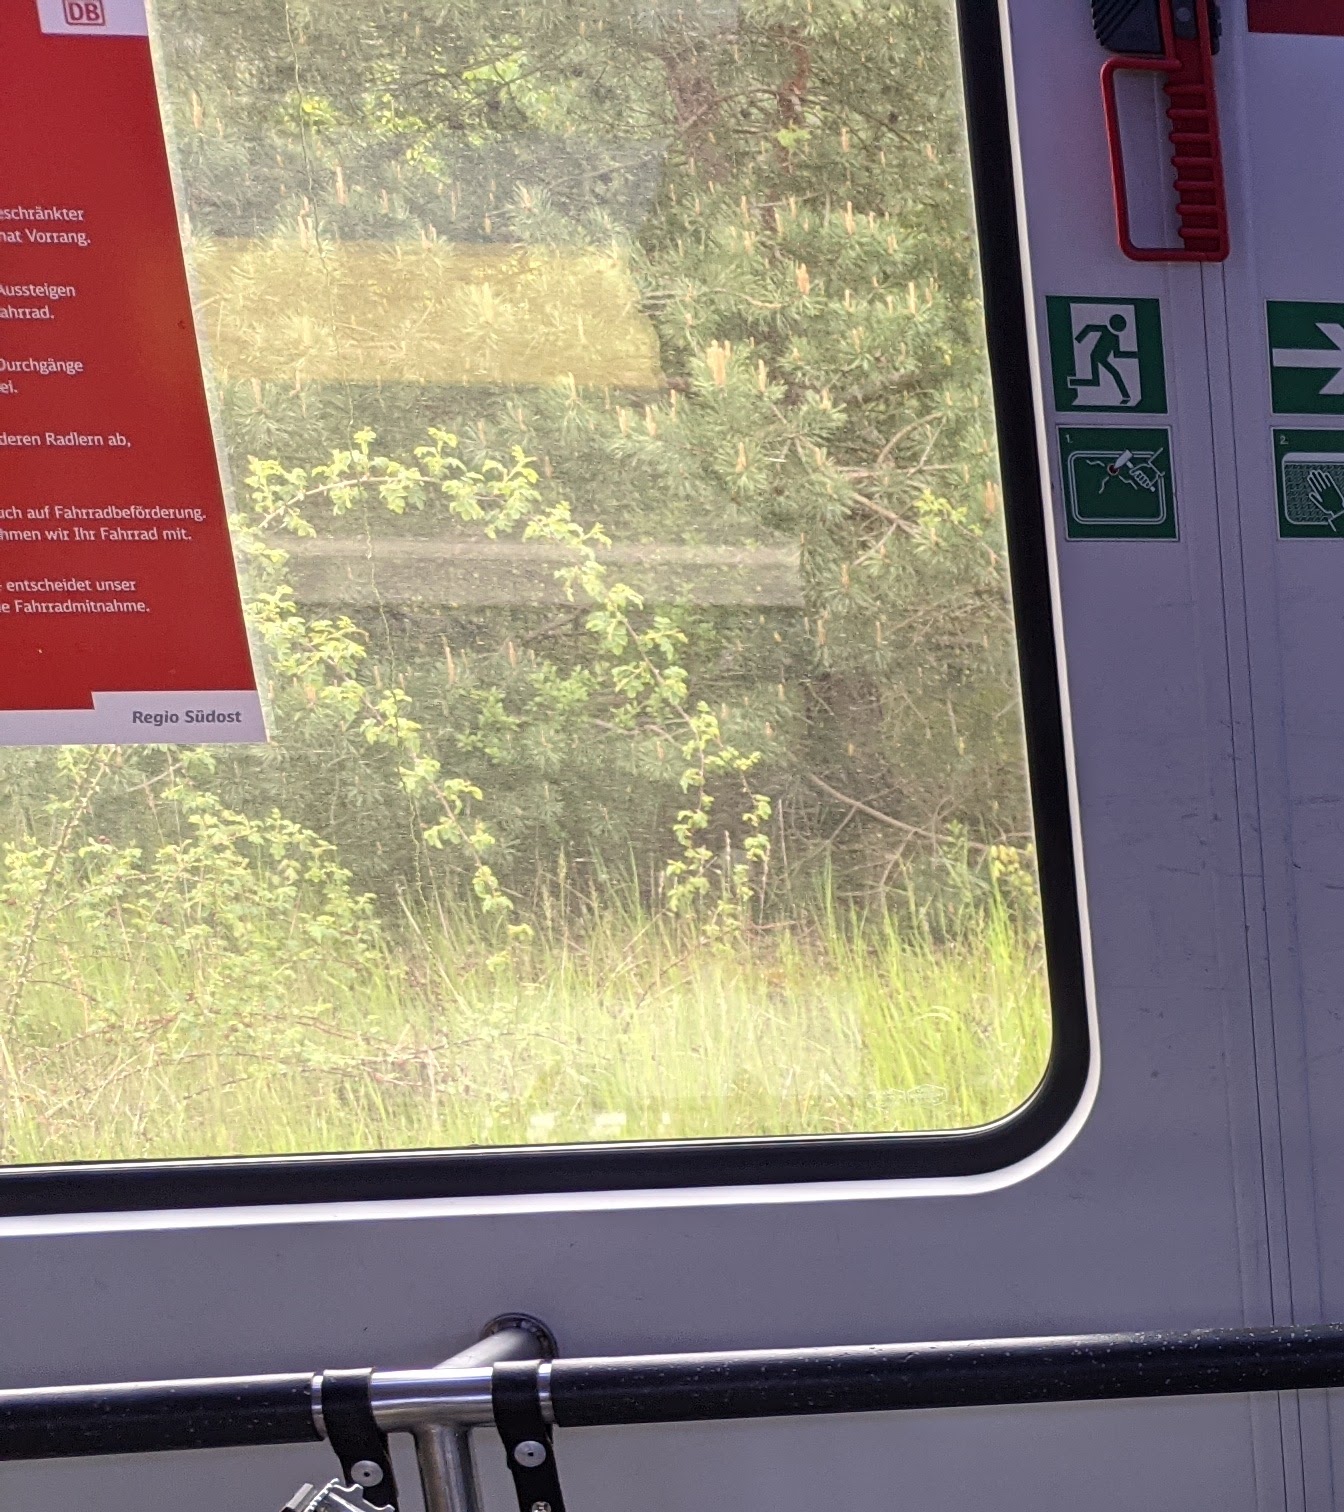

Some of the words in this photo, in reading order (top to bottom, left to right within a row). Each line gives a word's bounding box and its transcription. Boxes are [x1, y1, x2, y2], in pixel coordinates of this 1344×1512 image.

[68, 2, 101, 21] DB
[25, 227, 91, 247] Vorrang.
[46, 431, 104, 446] Radlern
[108, 432, 132, 448] ab,
[27, 505, 50, 519] auf
[55, 504, 207, 522] Fahrradbeförderung.
[45, 527, 71, 541] wir
[74, 527, 96, 541] Ihr
[100, 526, 159, 541] Fahrrad
[163, 527, 192, 541] mit.
[6, 578, 92, 592] entscheidet
[96, 579, 137, 592] unser
[14, 598, 150, 613] Fahrradmitnahme.
[132, 710, 180, 727] Regio
[184, 708, 242, 724] Südost
